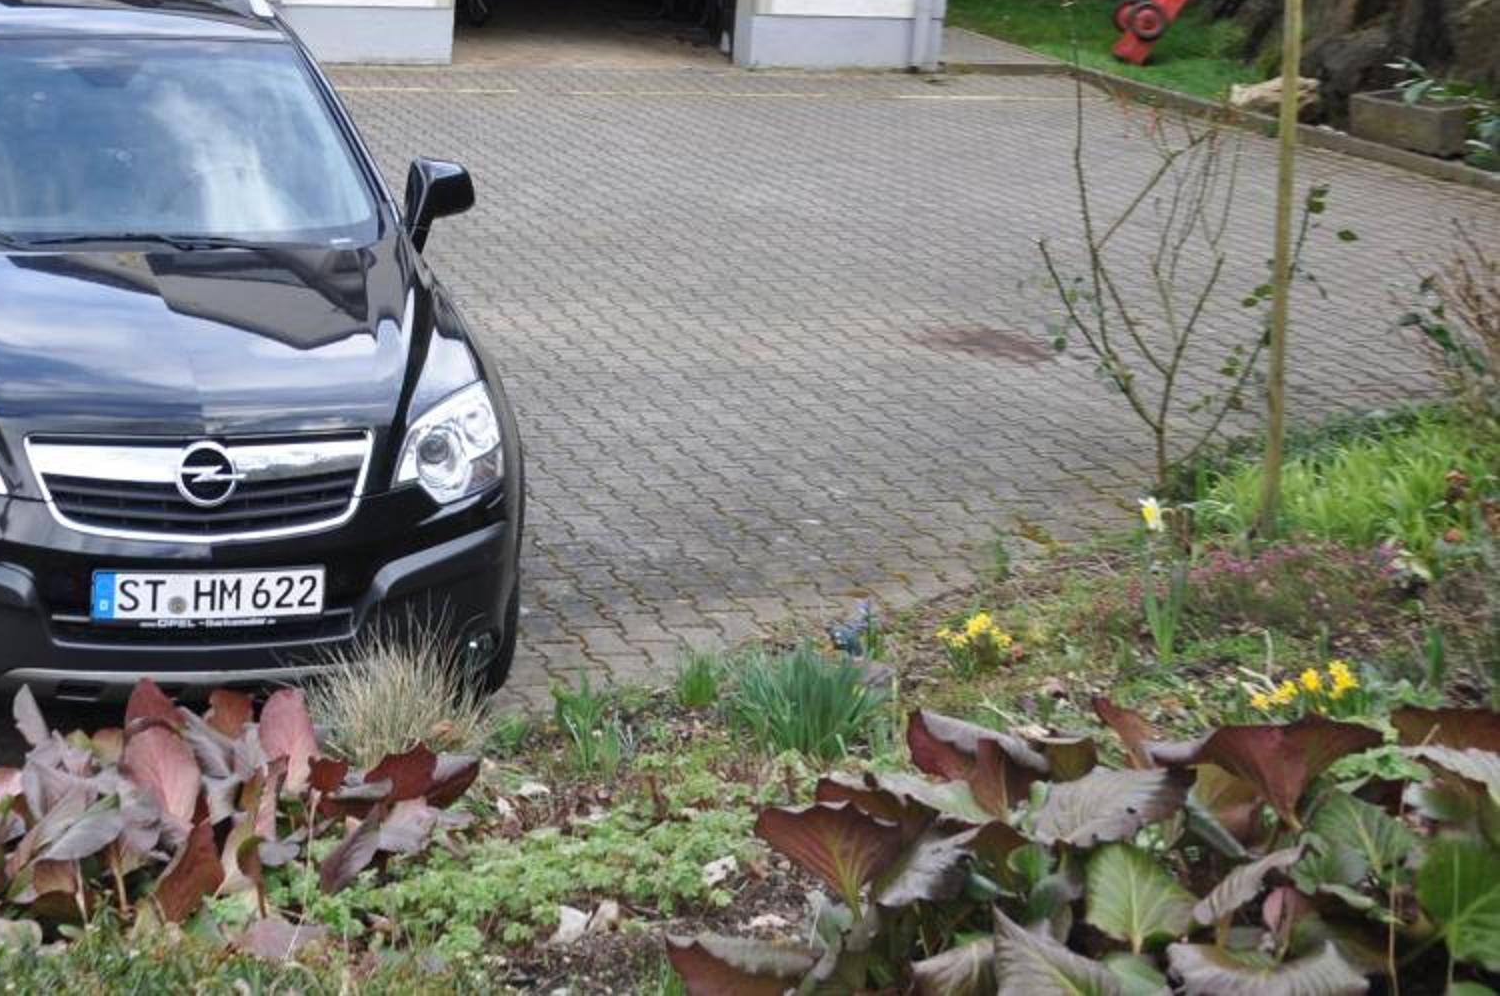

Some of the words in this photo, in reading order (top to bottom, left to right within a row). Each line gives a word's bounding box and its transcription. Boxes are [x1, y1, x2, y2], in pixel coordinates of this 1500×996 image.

[118, 579, 166, 612] ST
[193, 578, 242, 611] HM
[251, 575, 317, 609] 622
